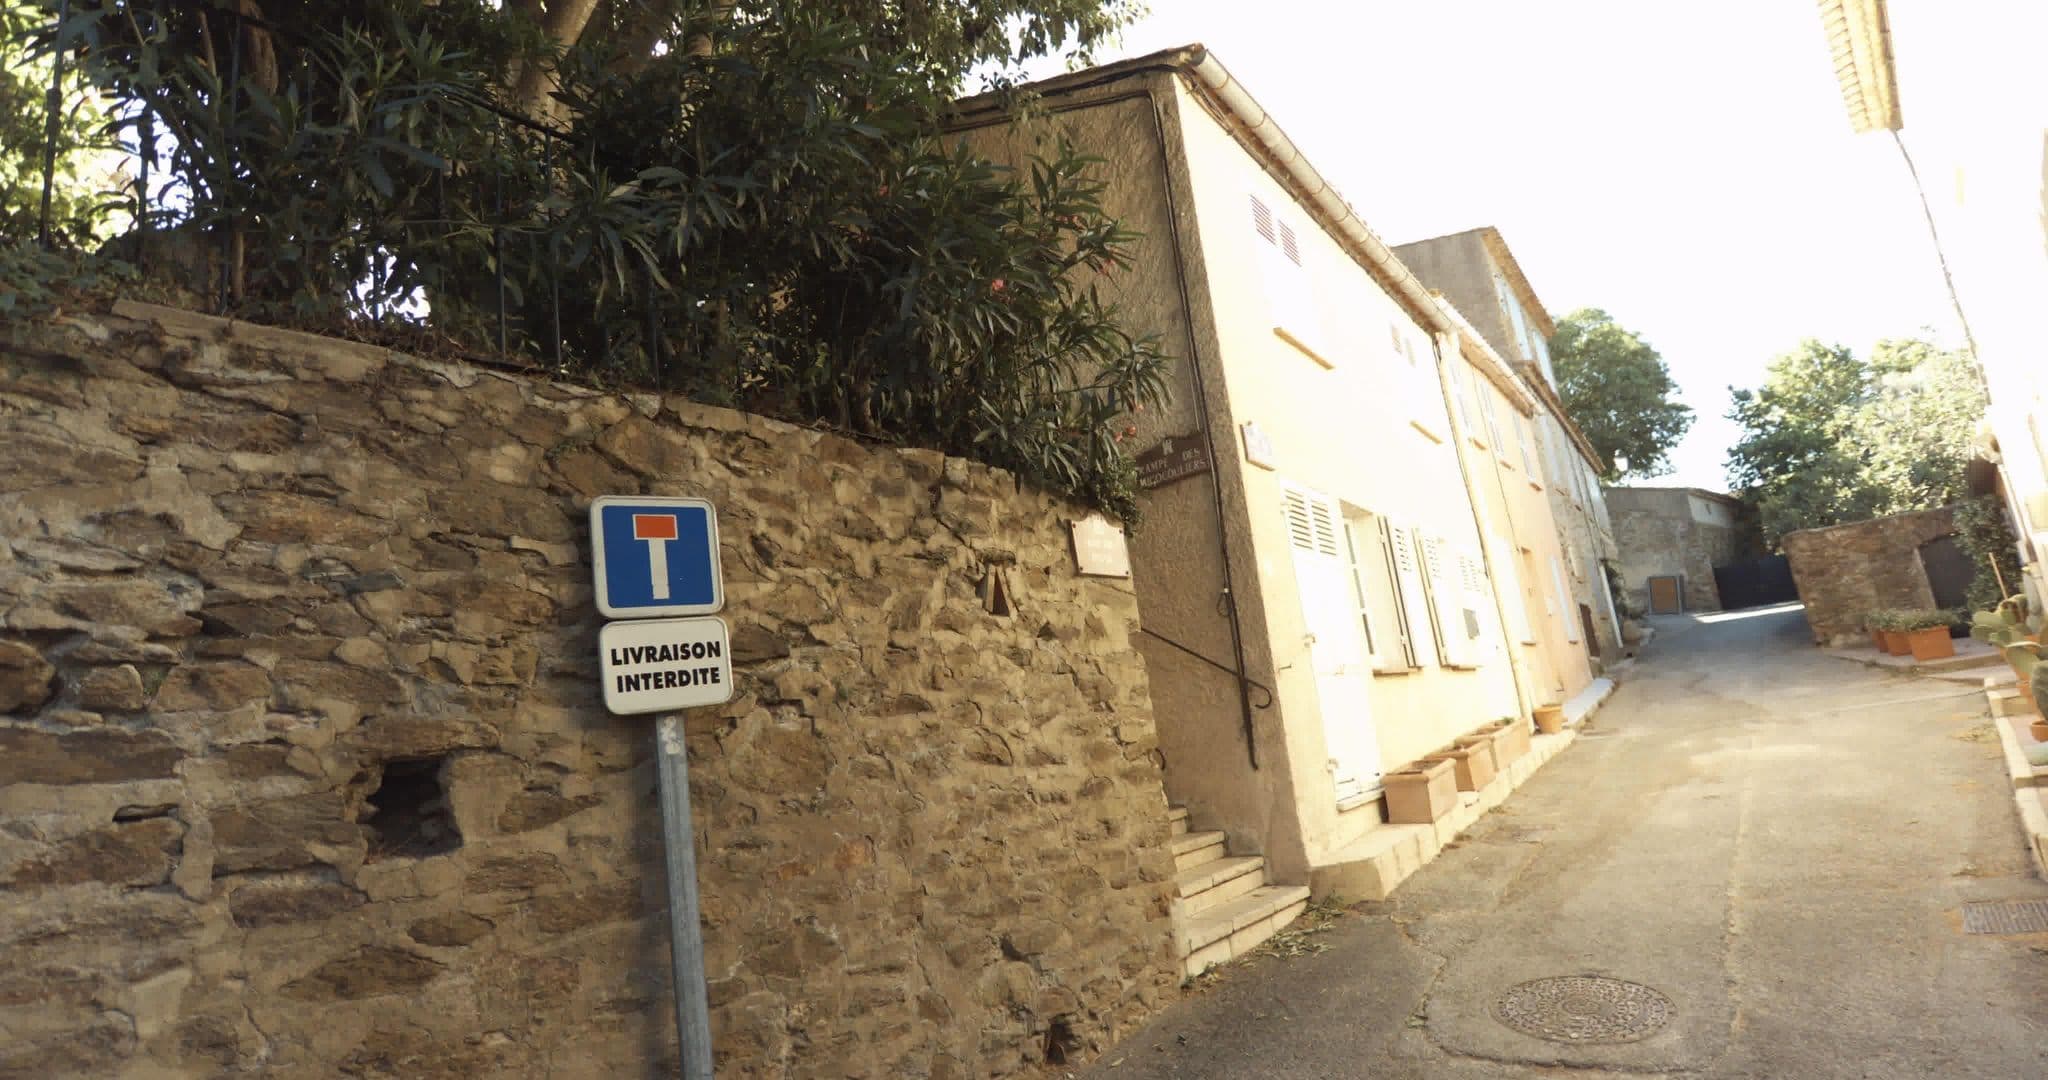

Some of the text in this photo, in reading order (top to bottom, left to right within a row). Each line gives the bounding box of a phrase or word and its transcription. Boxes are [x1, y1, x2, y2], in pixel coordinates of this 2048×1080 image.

[1182, 447, 1200, 461] DES
[611, 641, 721, 665] LIVRAISON
[617, 667, 720, 693] INTERDITE
